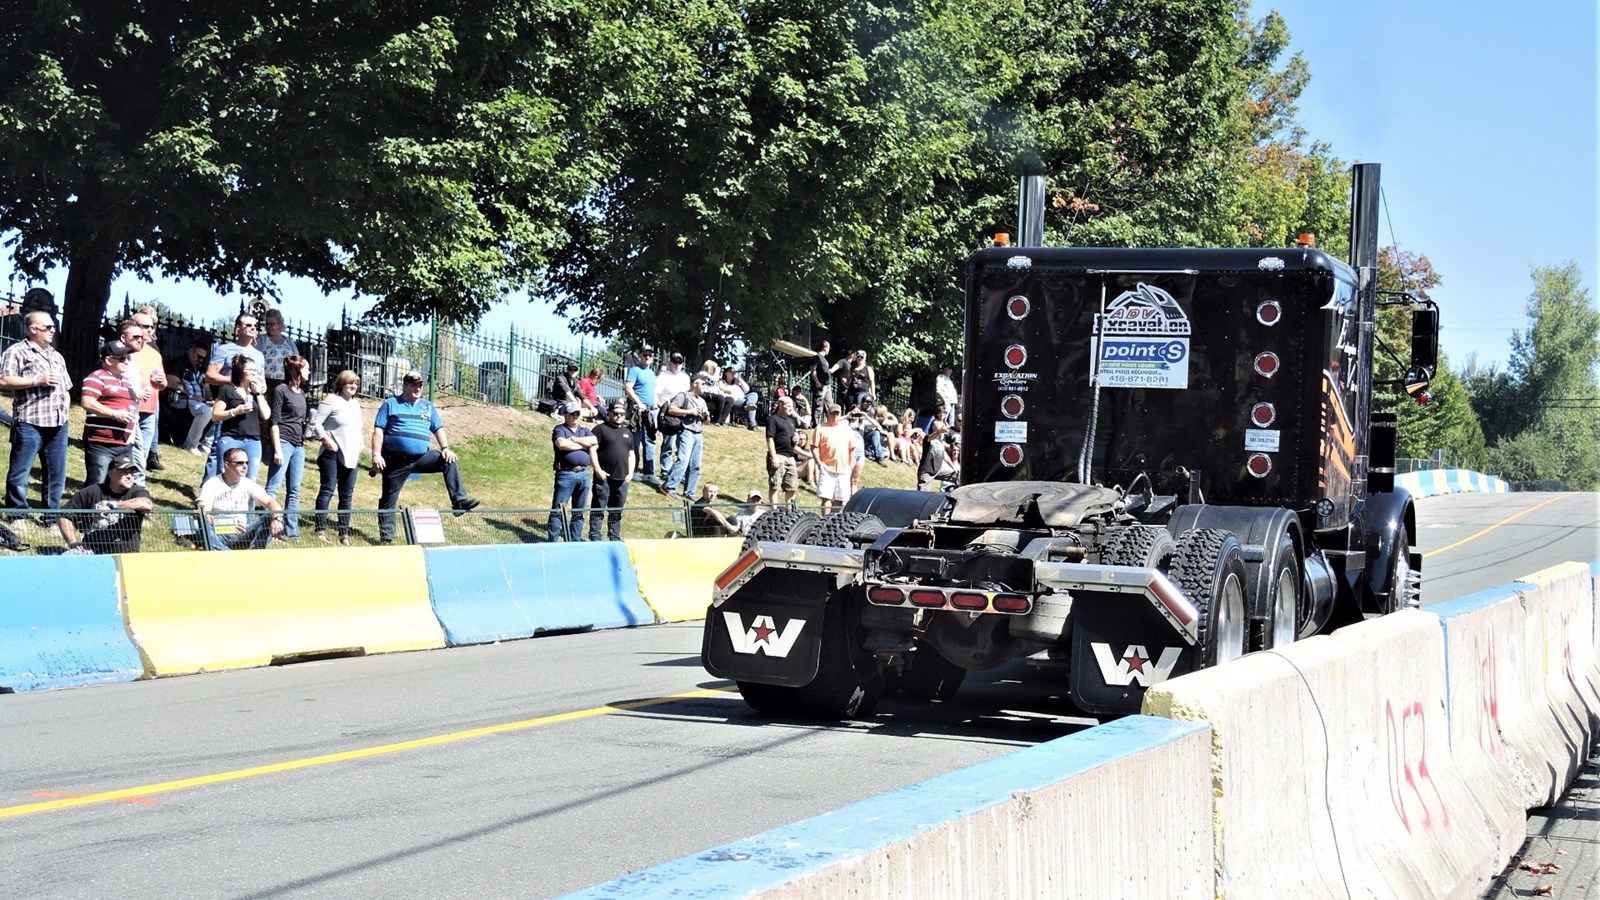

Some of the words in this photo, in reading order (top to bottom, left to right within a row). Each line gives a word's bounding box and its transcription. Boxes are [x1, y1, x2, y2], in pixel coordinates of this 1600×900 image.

[1110, 308, 1156, 319] ADV
[1104, 344, 1156, 358] point
[1108, 375, 1169, 383] 418-871-8281
